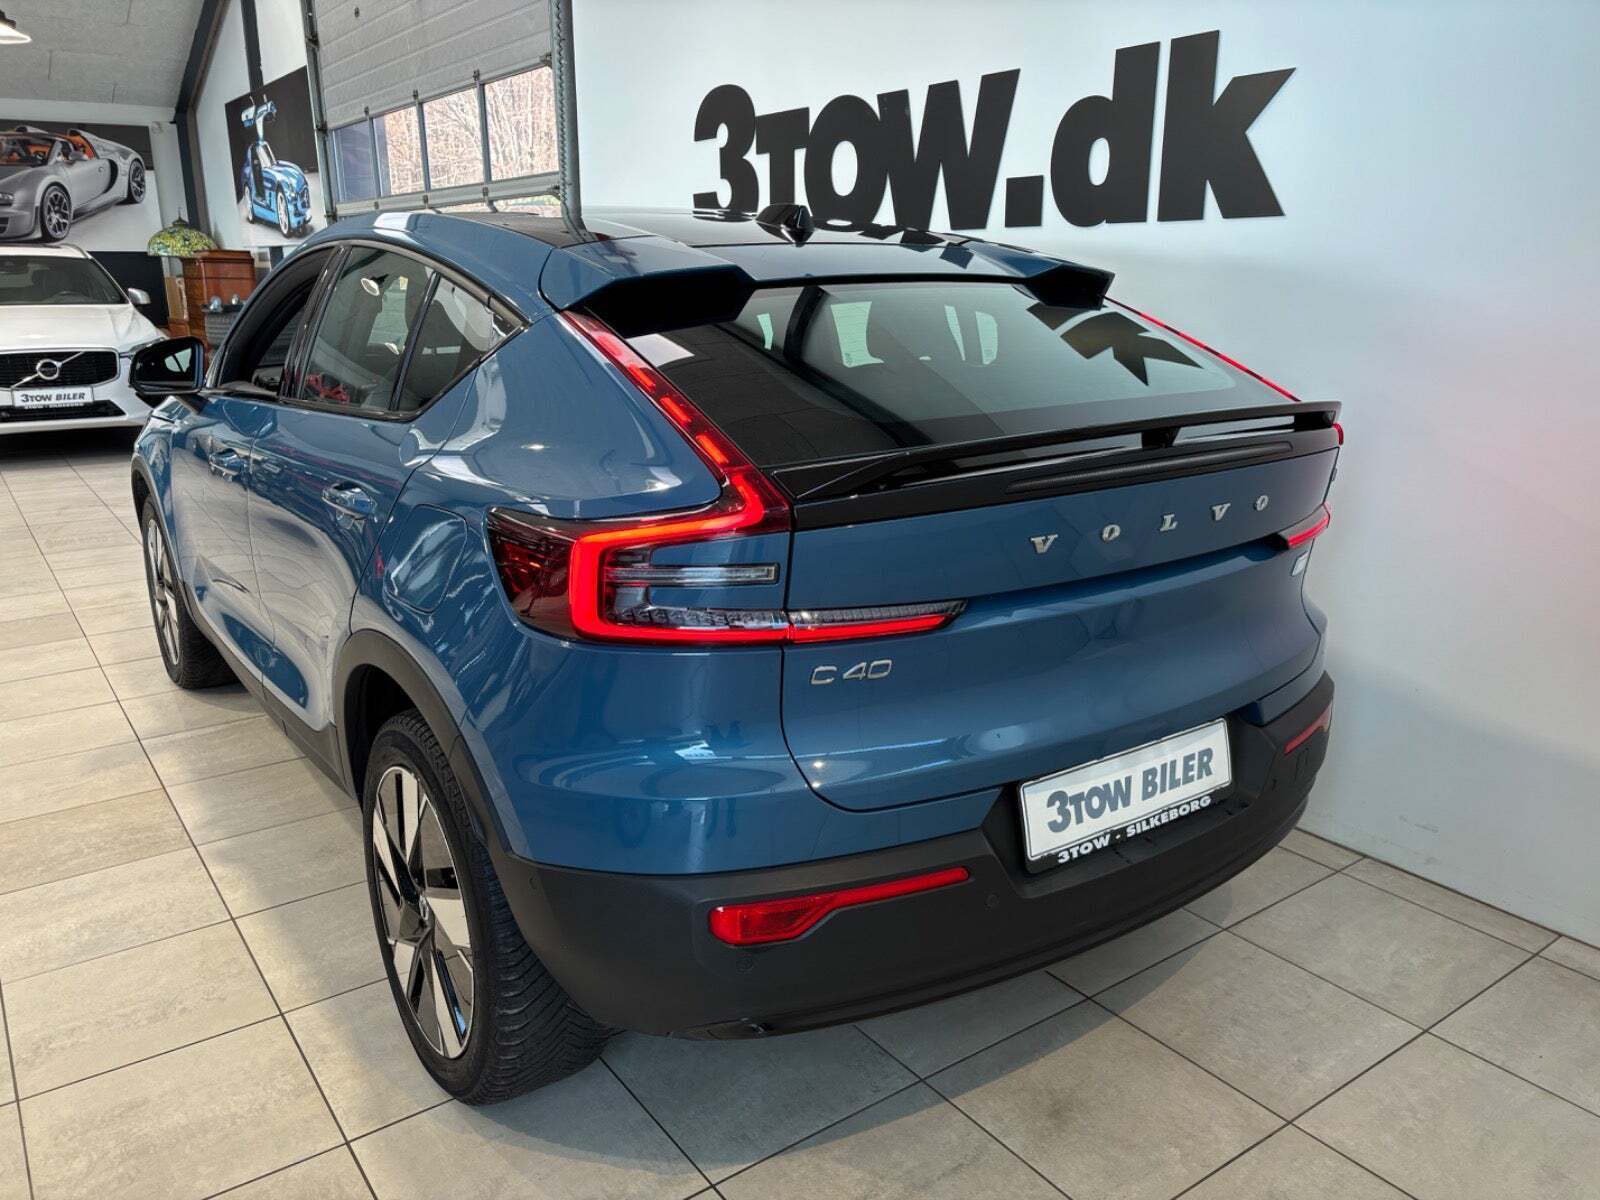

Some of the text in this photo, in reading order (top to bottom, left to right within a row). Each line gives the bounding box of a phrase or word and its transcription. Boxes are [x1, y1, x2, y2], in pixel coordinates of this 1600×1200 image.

[694, 29, 1296, 231] 3TOW.dk
[20, 392, 85, 403] 3TOW BILER
[1030, 495, 1269, 554] VOLVO
[811, 659, 892, 685] C40
[1046, 747, 1214, 833] 3TOW BILER
[1057, 795, 1212, 864] 3TOW SILKEBORG
